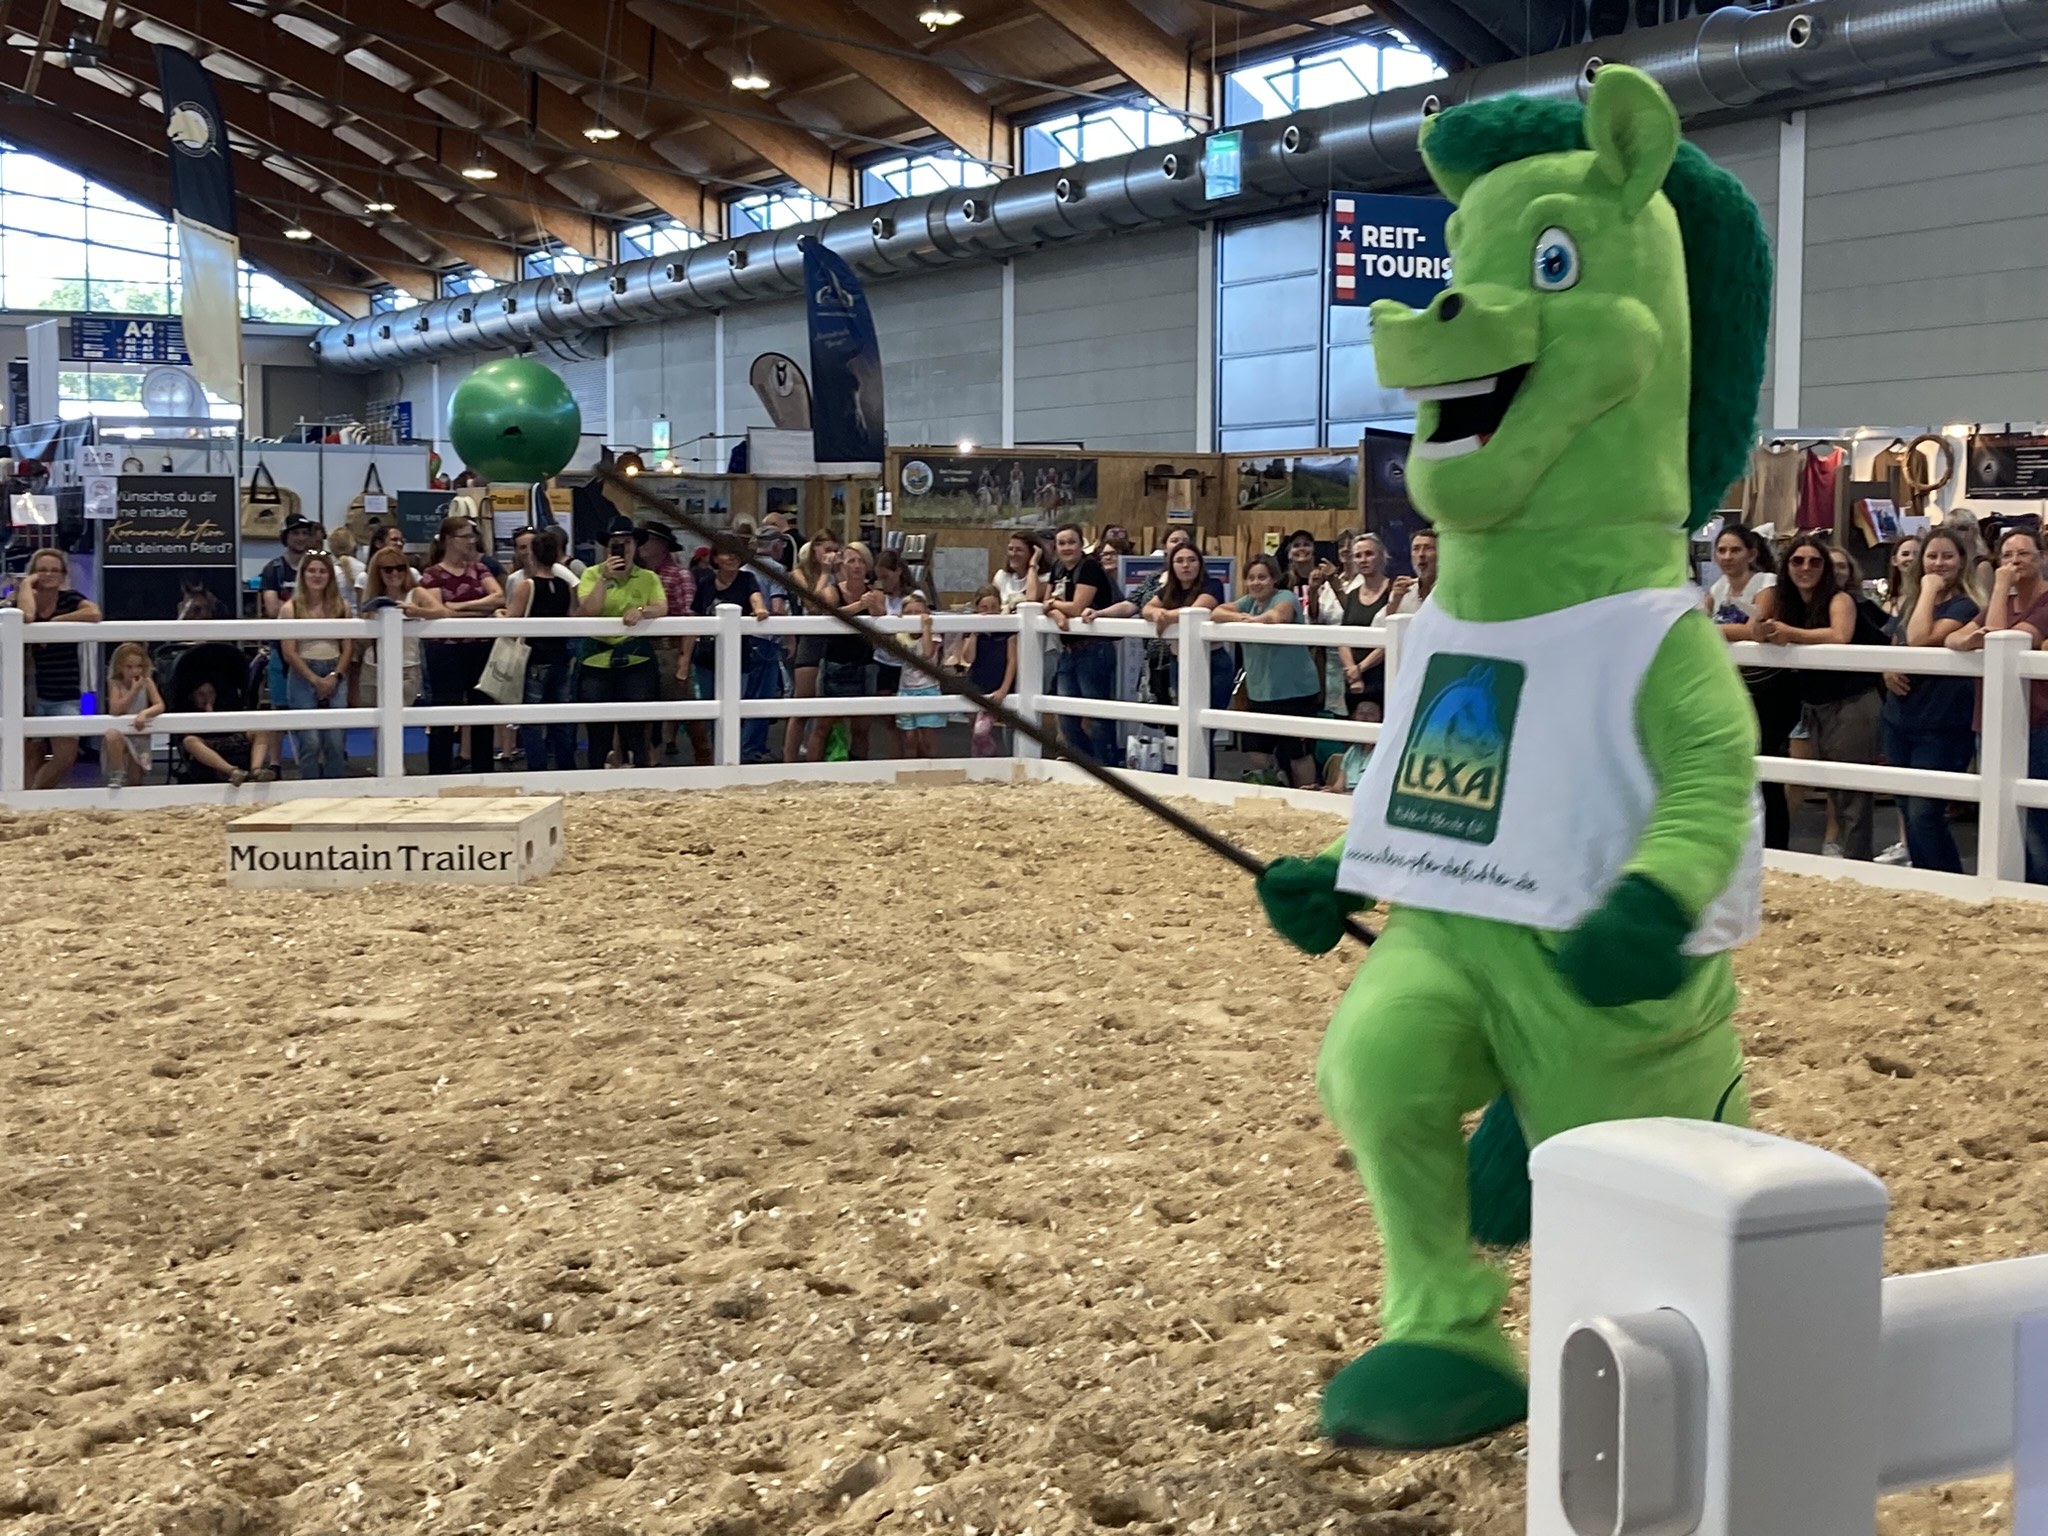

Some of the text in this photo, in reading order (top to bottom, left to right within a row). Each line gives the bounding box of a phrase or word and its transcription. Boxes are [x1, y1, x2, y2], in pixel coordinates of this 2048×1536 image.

[1361, 225, 1426, 249] REIT-
[124, 321, 155, 338] A4
[117, 490, 217, 503] ünschst du dir
[140, 506, 188, 518] intakte
[108, 541, 233, 554] mit deinem Pferd?
[1404, 752, 1495, 800] LEXA
